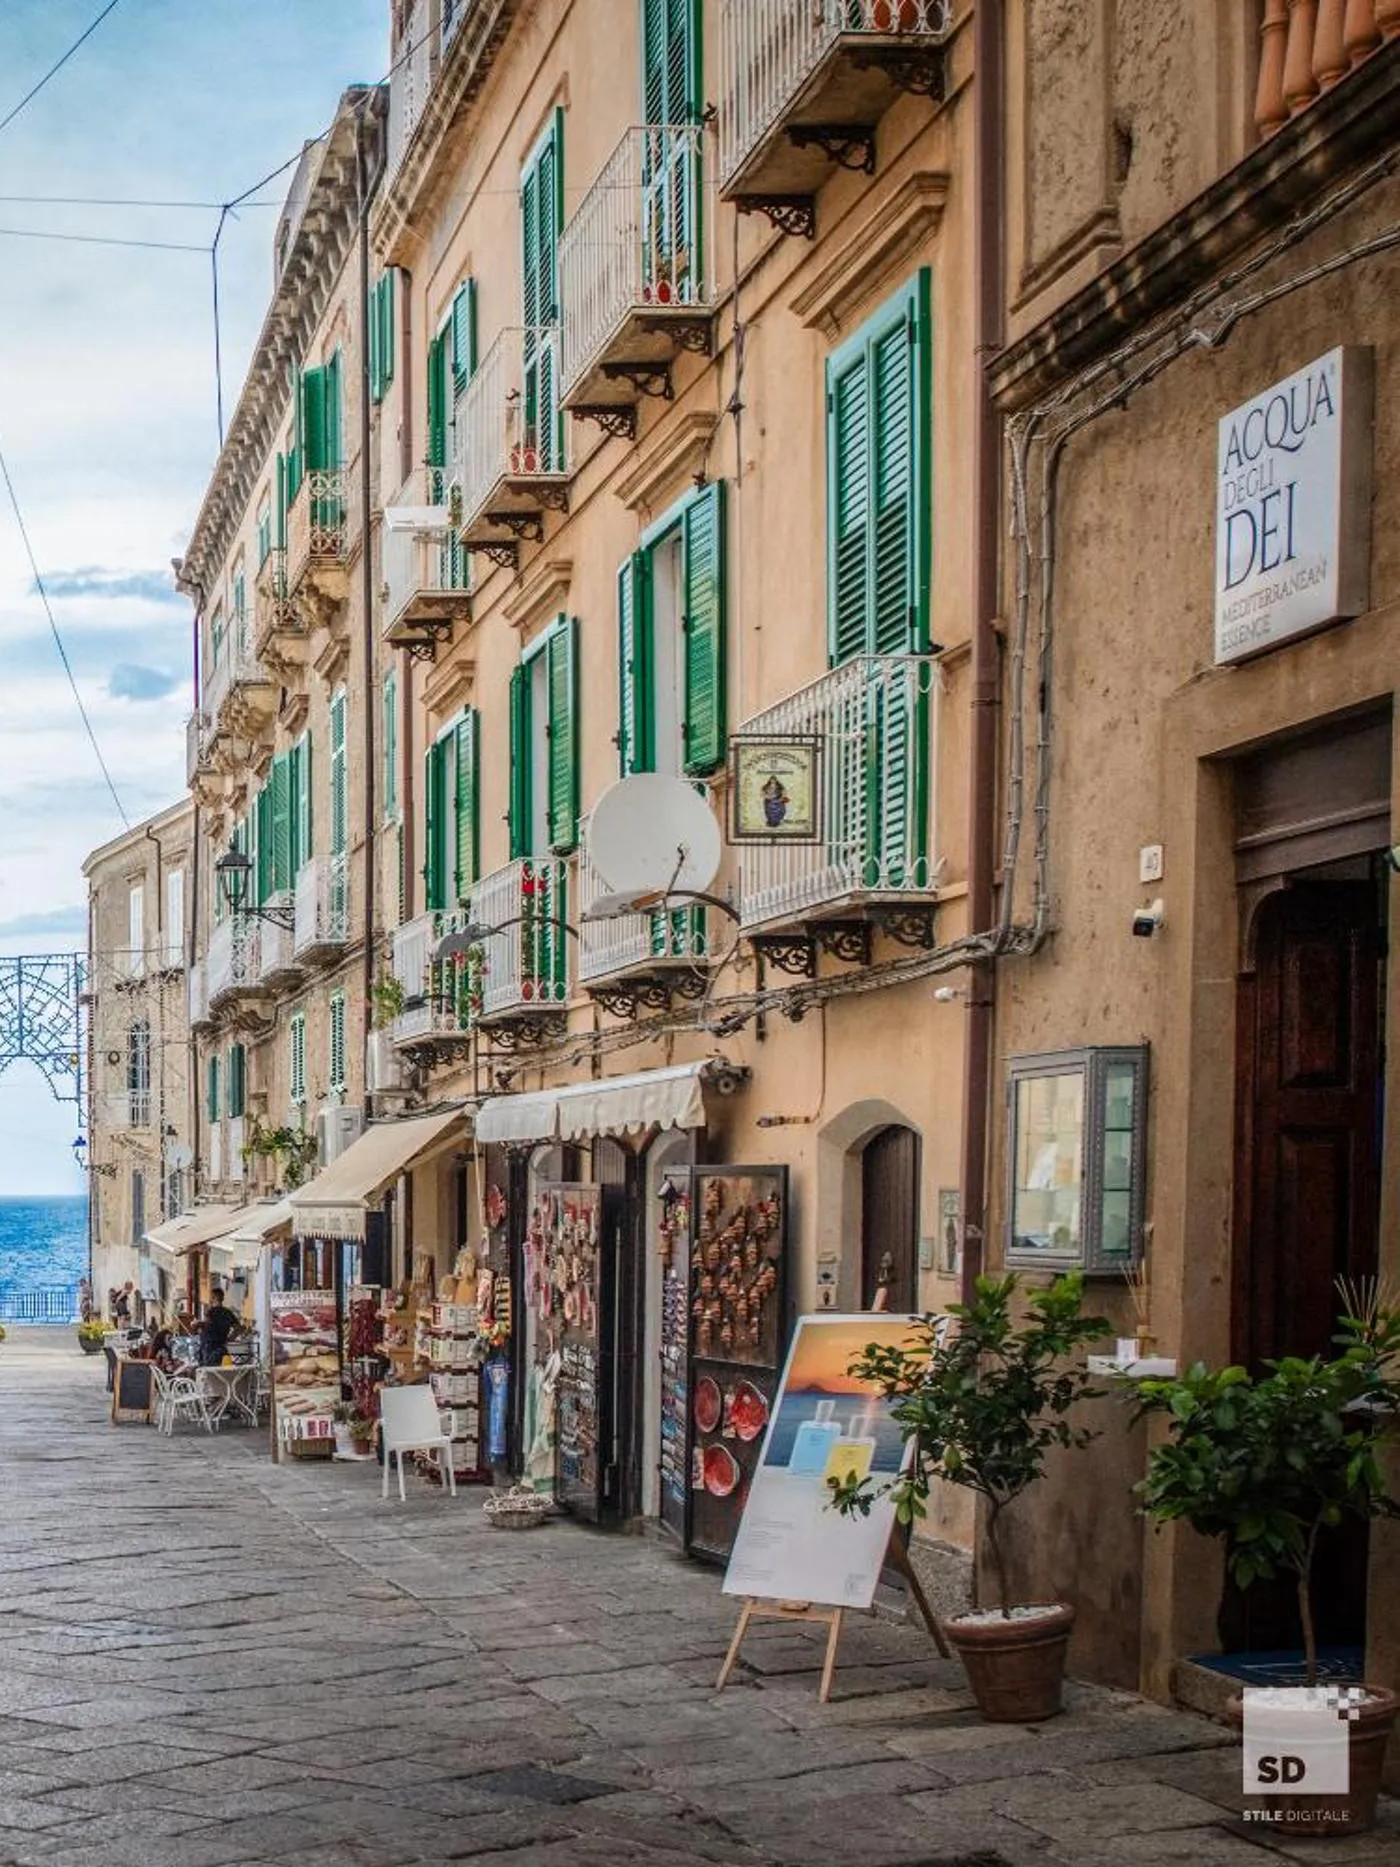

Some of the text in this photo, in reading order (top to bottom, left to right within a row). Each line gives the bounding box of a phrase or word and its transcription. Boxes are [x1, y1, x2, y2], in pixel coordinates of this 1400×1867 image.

[1223, 369, 1334, 476] ACQUA
[1224, 458, 1275, 510] DEGLI
[1224, 481, 1298, 591] DEI
[1221, 560, 1328, 625] MEDITERRANEAN
[1221, 615, 1272, 652] ESSENCE
